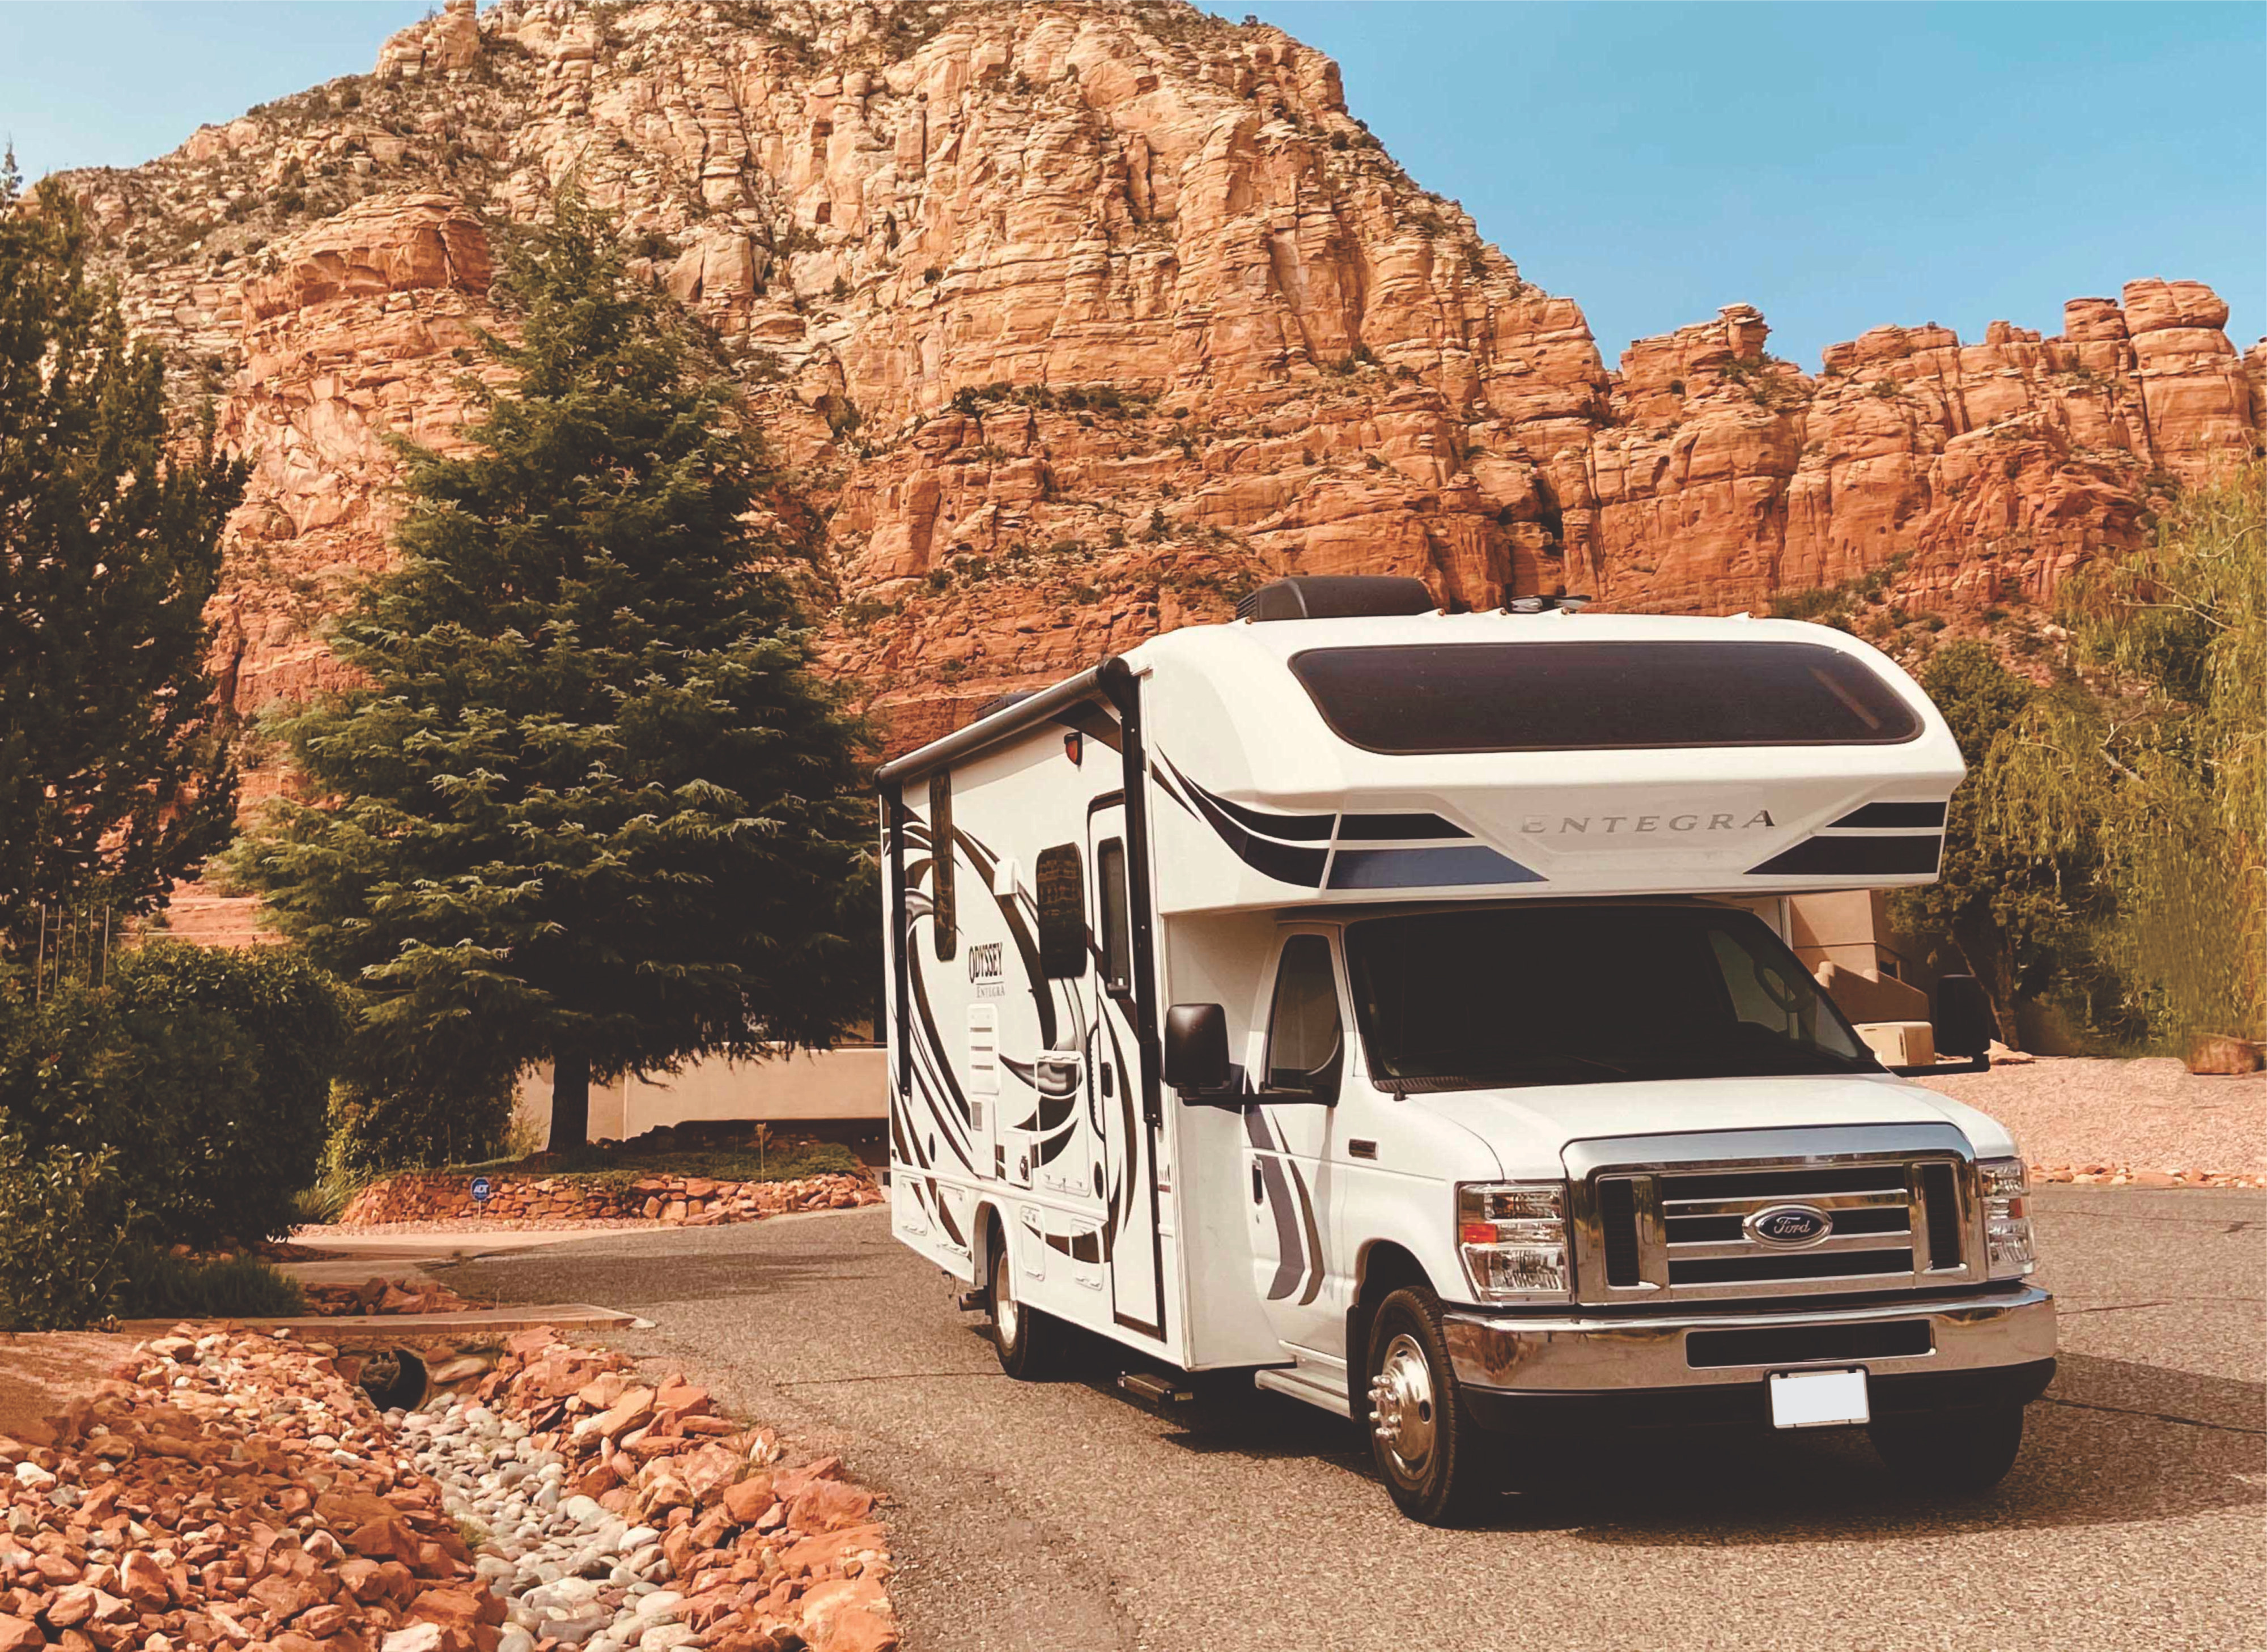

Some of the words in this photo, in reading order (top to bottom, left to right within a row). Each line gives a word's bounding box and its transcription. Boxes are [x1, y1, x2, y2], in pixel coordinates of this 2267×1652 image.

[1521, 809, 1776, 834] ENTEGRA
[969, 942, 1003, 983] ODYSSEY
[1774, 1216, 1811, 1234] Ford
